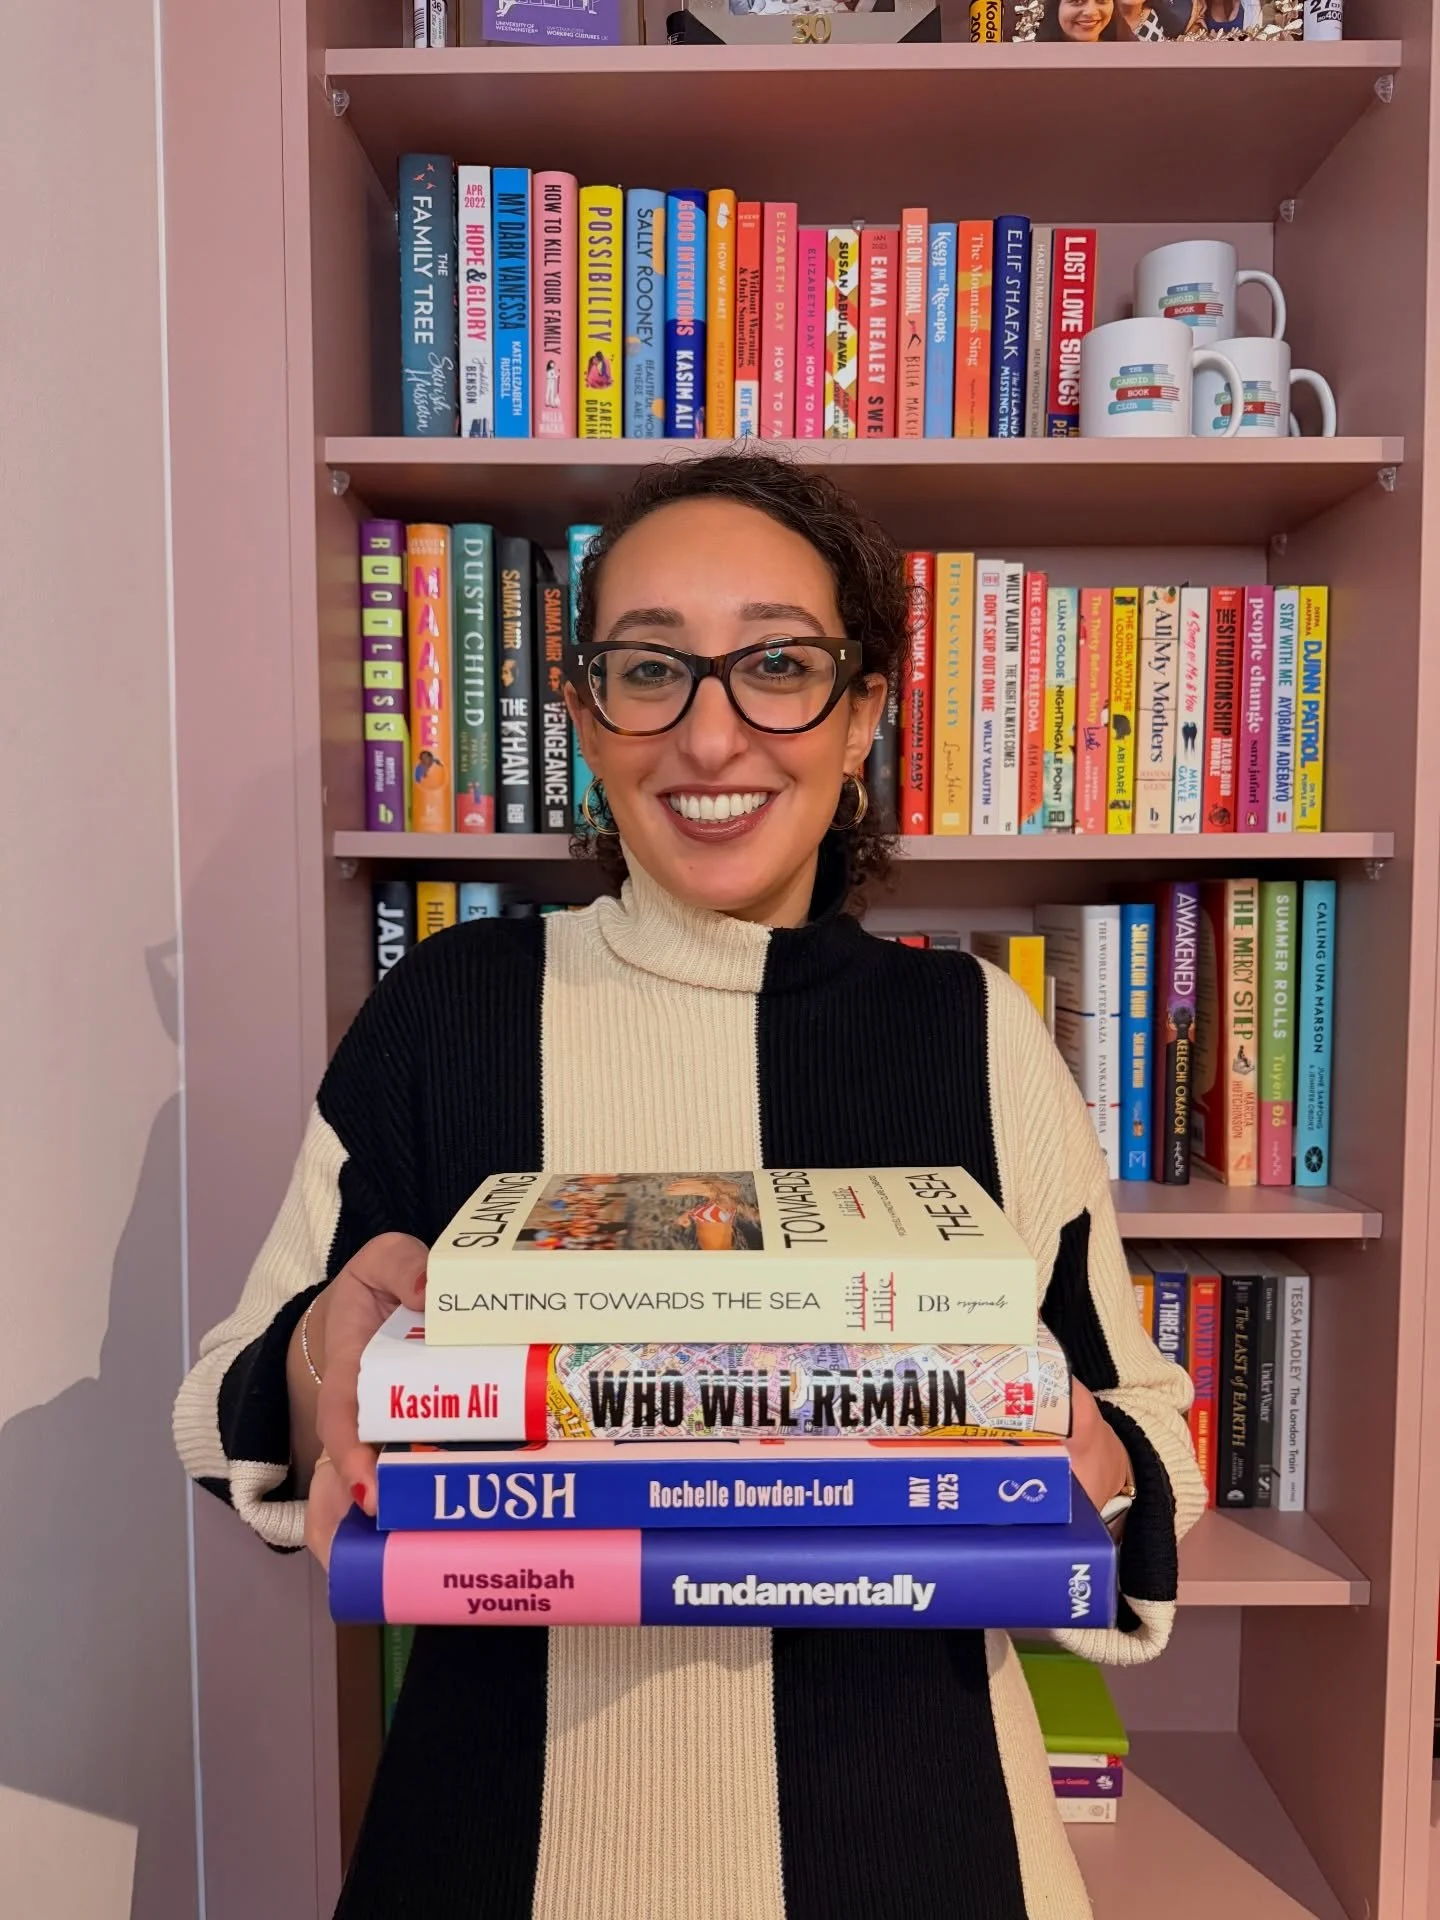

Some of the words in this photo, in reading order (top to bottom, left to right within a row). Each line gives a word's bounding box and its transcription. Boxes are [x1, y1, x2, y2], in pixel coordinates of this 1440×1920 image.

[546, 30, 573, 38] WORKING
[793, 15, 831, 43] 30
[971, 12, 981, 42] 200
[464, 197, 485, 208] 2022
[466, 184, 483, 196] APR
[498, 193, 525, 216] MY
[544, 184, 561, 213] HOW
[413, 196, 433, 278] FAMILY
[498, 221, 525, 260] DARK
[544, 218, 561, 234] TO
[636, 208, 653, 262] SALLY
[678, 200, 695, 242] GOOD
[905, 224, 922, 244] JOG
[437, 253, 448, 277] THE
[465, 225, 485, 266] HOPE
[544, 239, 561, 267] KILL
[776, 212, 787, 293] ELIZABETH
[904, 247, 922, 263] ON
[971, 234, 984, 260] The
[1006, 230, 1023, 274] ELIF
[1035, 244, 1045, 284] HARUKI
[1062, 236, 1087, 282] LOST
[588, 207, 612, 342] POSSIBILITY
[807, 248, 817, 317] ELIZABETH
[838, 242, 849, 289] SUSAN
[870, 256, 888, 308] EMMA
[498, 265, 526, 330] VANESSA
[544, 271, 561, 305] YOUR
[636, 266, 653, 347] ROONEY
[677, 247, 695, 336] INTENTIONS
[903, 266, 922, 316] JOURNAL
[970, 265, 984, 333] Mountains
[414, 284, 434, 345] TREE
[466, 285, 486, 341] GLORY
[775, 303, 785, 331] DAY
[1004, 277, 1021, 360] SHAFAK
[1033, 287, 1043, 341] MURAKAMI
[1061, 288, 1085, 333] LOVE
[1174, 305, 1195, 315] BOOK
[543, 309, 561, 355] FAMILY
[837, 294, 848, 371] ABULHAWA
[868, 317, 886, 384] HEALEY
[512, 341, 521, 363] KATE
[774, 347, 784, 384] HOW
[967, 337, 981, 367] Sing
[465, 366, 477, 404] BENSON
[501, 357, 511, 399] RUSSELL
[512, 364, 522, 416] ELIZABETH
[676, 350, 694, 400] KASIM
[805, 356, 815, 388] HOW
[1058, 338, 1081, 406] SONGS
[1116, 376, 1149, 387] CANDID
[773, 392, 784, 412] TO
[1127, 388, 1150, 397] BOOK
[675, 405, 694, 429] ALI
[464, 538, 484, 621] DUST
[503, 570, 521, 618] SAIMA
[1006, 573, 1020, 607] WILLY
[1031, 580, 1042, 602] THE
[503, 621, 521, 649] MIR
[1005, 610, 1020, 651] VLAUTIN
[1057, 600, 1066, 631] LUAN
[1124, 609, 1134, 629] THE
[1155, 608, 1172, 636] All
[1216, 609, 1236, 625] THE
[1248, 598, 1266, 661] people
[1280, 603, 1294, 631] STAY
[983, 628, 997, 653] SKIP
[1030, 608, 1041, 664] GREATER
[1115, 618, 1124, 669] LOUDING
[1124, 631, 1134, 656] GIRL
[1279, 634, 1294, 665] WITH
[982, 656, 996, 677] OUT
[1056, 635, 1066, 678] GOLDIE
[1148, 642, 1171, 676] My
[1302, 640, 1322, 694] DJINN
[464, 631, 485, 726] CHILD
[982, 679, 995, 694] ON
[1114, 672, 1123, 703] VOICE
[1214, 625, 1236, 736] SITUATIONSHIP
[1278, 669, 1292, 686] ME
[500, 698, 528, 716] THE
[912, 688, 924, 747] BROWN
[981, 696, 995, 712] ME
[1028, 667, 1040, 732] FREEDOM
[1246, 665, 1265, 733] change
[983, 720, 992, 754] WILLY
[1054, 685, 1065, 764] NIGHTINGALE
[1150, 681, 1170, 763] Mothers
[1300, 700, 1320, 768] PATROL
[501, 720, 529, 785] KHAN
[544, 702, 567, 805] VENGEANCE
[911, 752, 924, 792] BABY
[1117, 745, 1125, 764] ABI
[1250, 740, 1258, 766] sara
[982, 757, 992, 805] VLAUTIN
[1053, 768, 1063, 801] POINT
[1178, 765, 1187, 801] GAYLE
[1188, 768, 1197, 798] MIKE
[1233, 887, 1254, 930] THE
[1099, 921, 1107, 940] THE
[1174, 893, 1197, 995] AWAKENED
[1274, 895, 1290, 972] SUMMER
[1315, 902, 1328, 960] CALLING
[1099, 943, 1107, 981] WORLD
[1233, 937, 1254, 984] MERCY
[1314, 963, 1326, 992] UNA
[1099, 985, 1107, 1017] AFTER
[1233, 991, 1254, 1039] STEP
[1272, 980, 1288, 1039] ROLLS
[1313, 996, 1325, 1053] MARSON
[1099, 1055, 1107, 1093] PANKAJ
[1175, 1038, 1189, 1083] KELECHI
[1099, 1096, 1107, 1134] MISHRA
[1174, 1086, 1188, 1135] OKAFOR
[1232, 1080, 1244, 1139] HUTCHINSON
[1244, 1091, 1255, 1127] MARCIA
[905, 1173, 957, 1199] SEA
[451, 1174, 538, 1248] SLANTING
[769, 1171, 828, 1249] TOWARDS
[924, 1204, 984, 1241] THE
[438, 1293, 567, 1312] SLANTING
[573, 1292, 705, 1310] TOWARDS
[712, 1292, 762, 1310] THE
[769, 1292, 821, 1310] SEA
[918, 1294, 951, 1312] DB
[956, 1294, 1009, 1314] originals
[1290, 1287, 1303, 1325] TESSA
[1233, 1333, 1249, 1374] LAST
[1290, 1331, 1303, 1381] HADLEY
[389, 1385, 460, 1419] Kasim
[467, 1383, 499, 1418] Ali
[588, 1370, 685, 1428] WHO
[697, 1369, 799, 1427] WILL
[812, 1369, 966, 1427] REMAIN
[1290, 1387, 1300, 1406] The
[1232, 1391, 1247, 1447] EARTH
[1289, 1409, 1300, 1450] London
[1289, 1451, 1300, 1474] Train
[433, 1472, 577, 1520] LUSH
[649, 1480, 729, 1509] Rochelle
[734, 1479, 855, 1508] Dowden-Lord
[908, 1476, 931, 1508] MAY
[937, 1473, 960, 1510] 2025
[442, 1568, 575, 1589] nussaibah
[672, 1574, 937, 1612] fundamentally
[467, 1594, 552, 1615] younis
